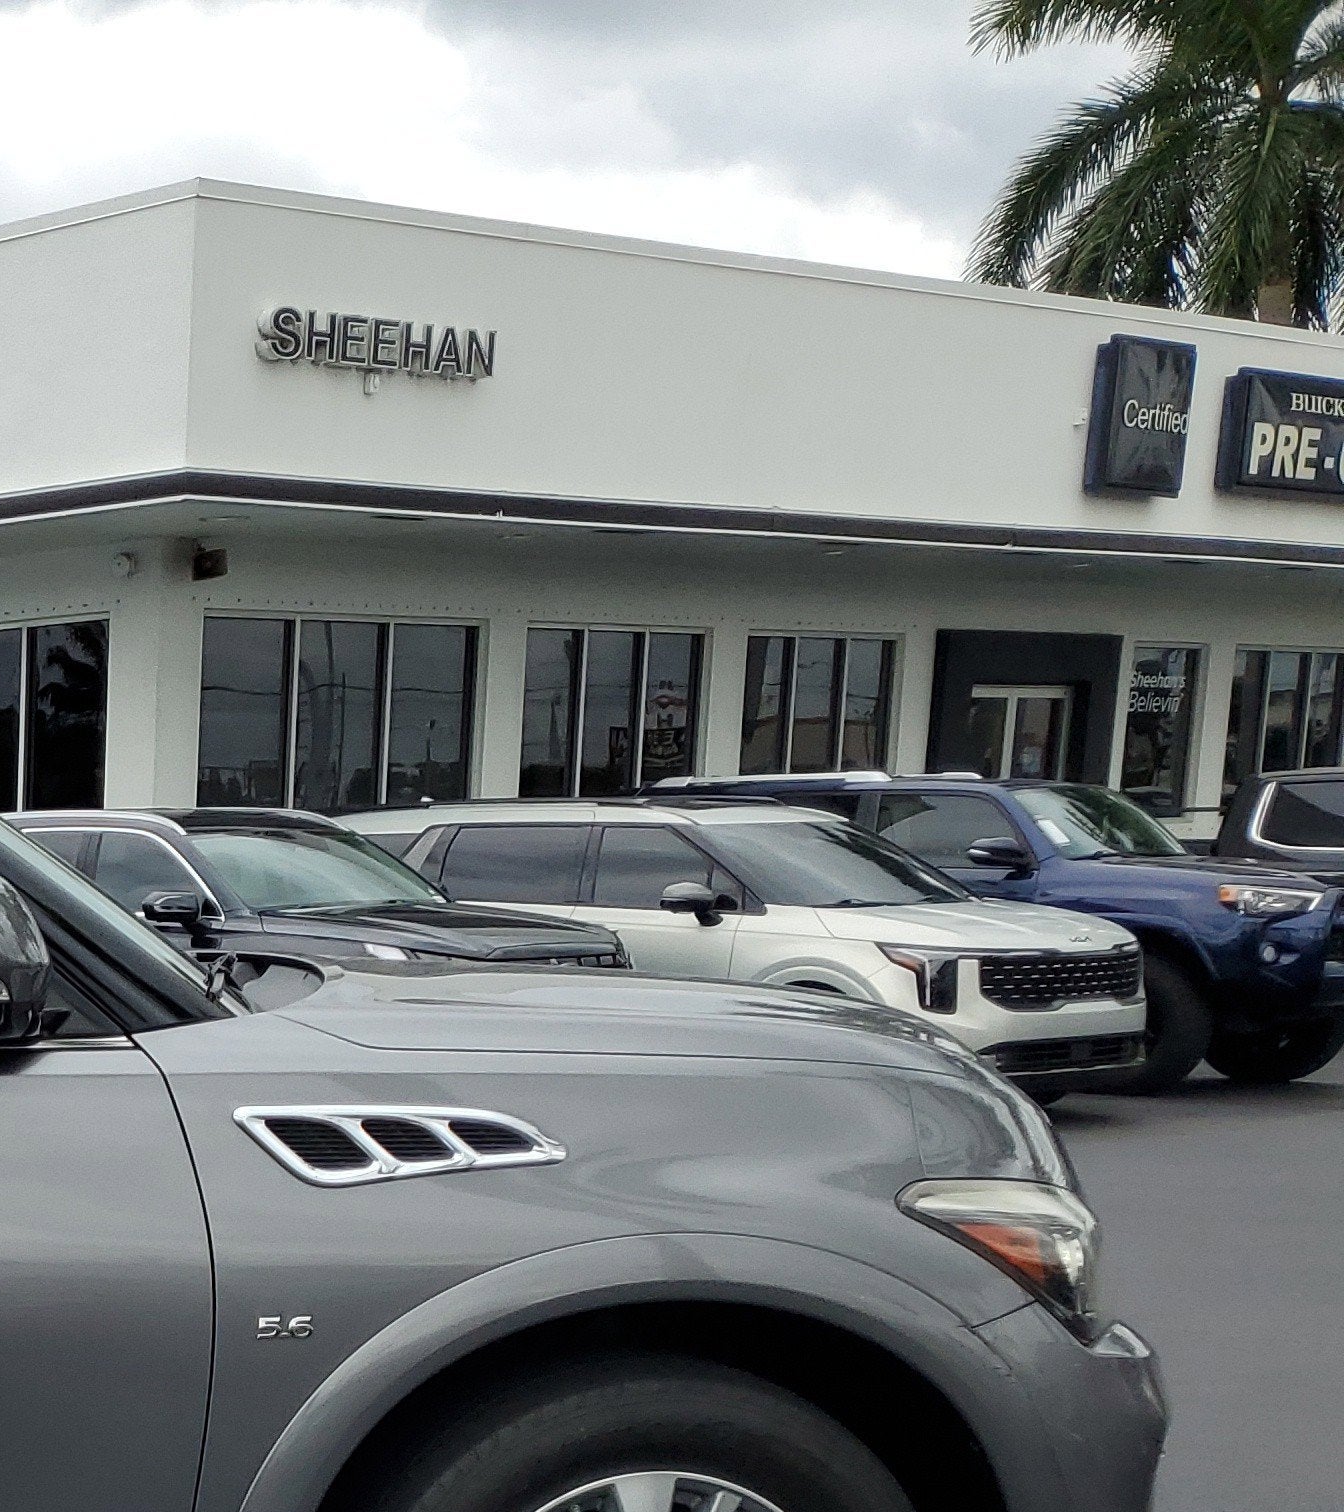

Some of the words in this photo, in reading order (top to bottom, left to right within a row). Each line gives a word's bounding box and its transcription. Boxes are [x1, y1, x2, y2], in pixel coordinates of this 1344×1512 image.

[269, 306, 496, 377] SHEEHAN
[1124, 400, 1189, 434] Certified
[1290, 393, 1344, 417] BUICK
[1249, 422, 1344, 485] PRE-
[257, 1316, 314, 1339] 5.6
